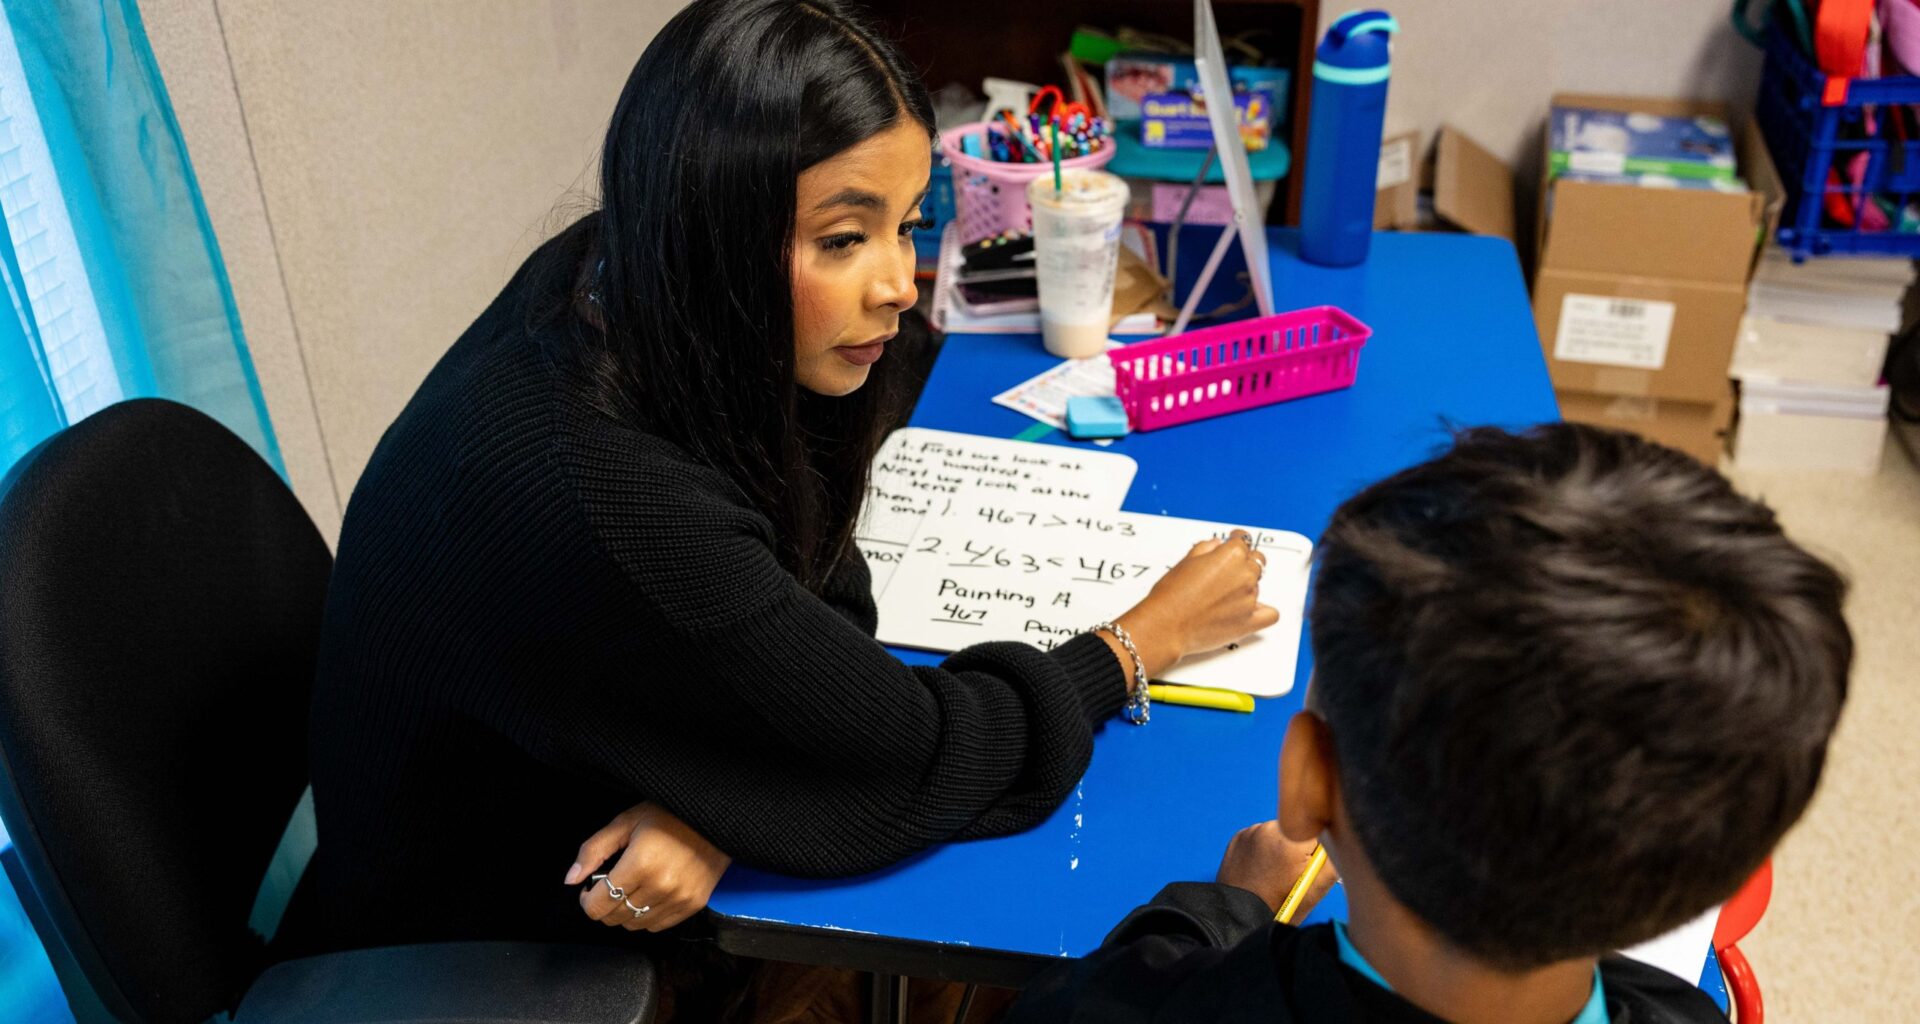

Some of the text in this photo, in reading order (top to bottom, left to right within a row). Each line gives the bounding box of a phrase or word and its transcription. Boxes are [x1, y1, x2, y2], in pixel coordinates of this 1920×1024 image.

[920, 442, 963, 456] First
[879, 462, 929, 477] Next
[975, 478, 1017, 491] look
[1031, 486, 1053, 495] at
[1060, 488, 1091, 500] the
[938, 578, 1072, 608] Painting A
[942, 603, 988, 621] 467
